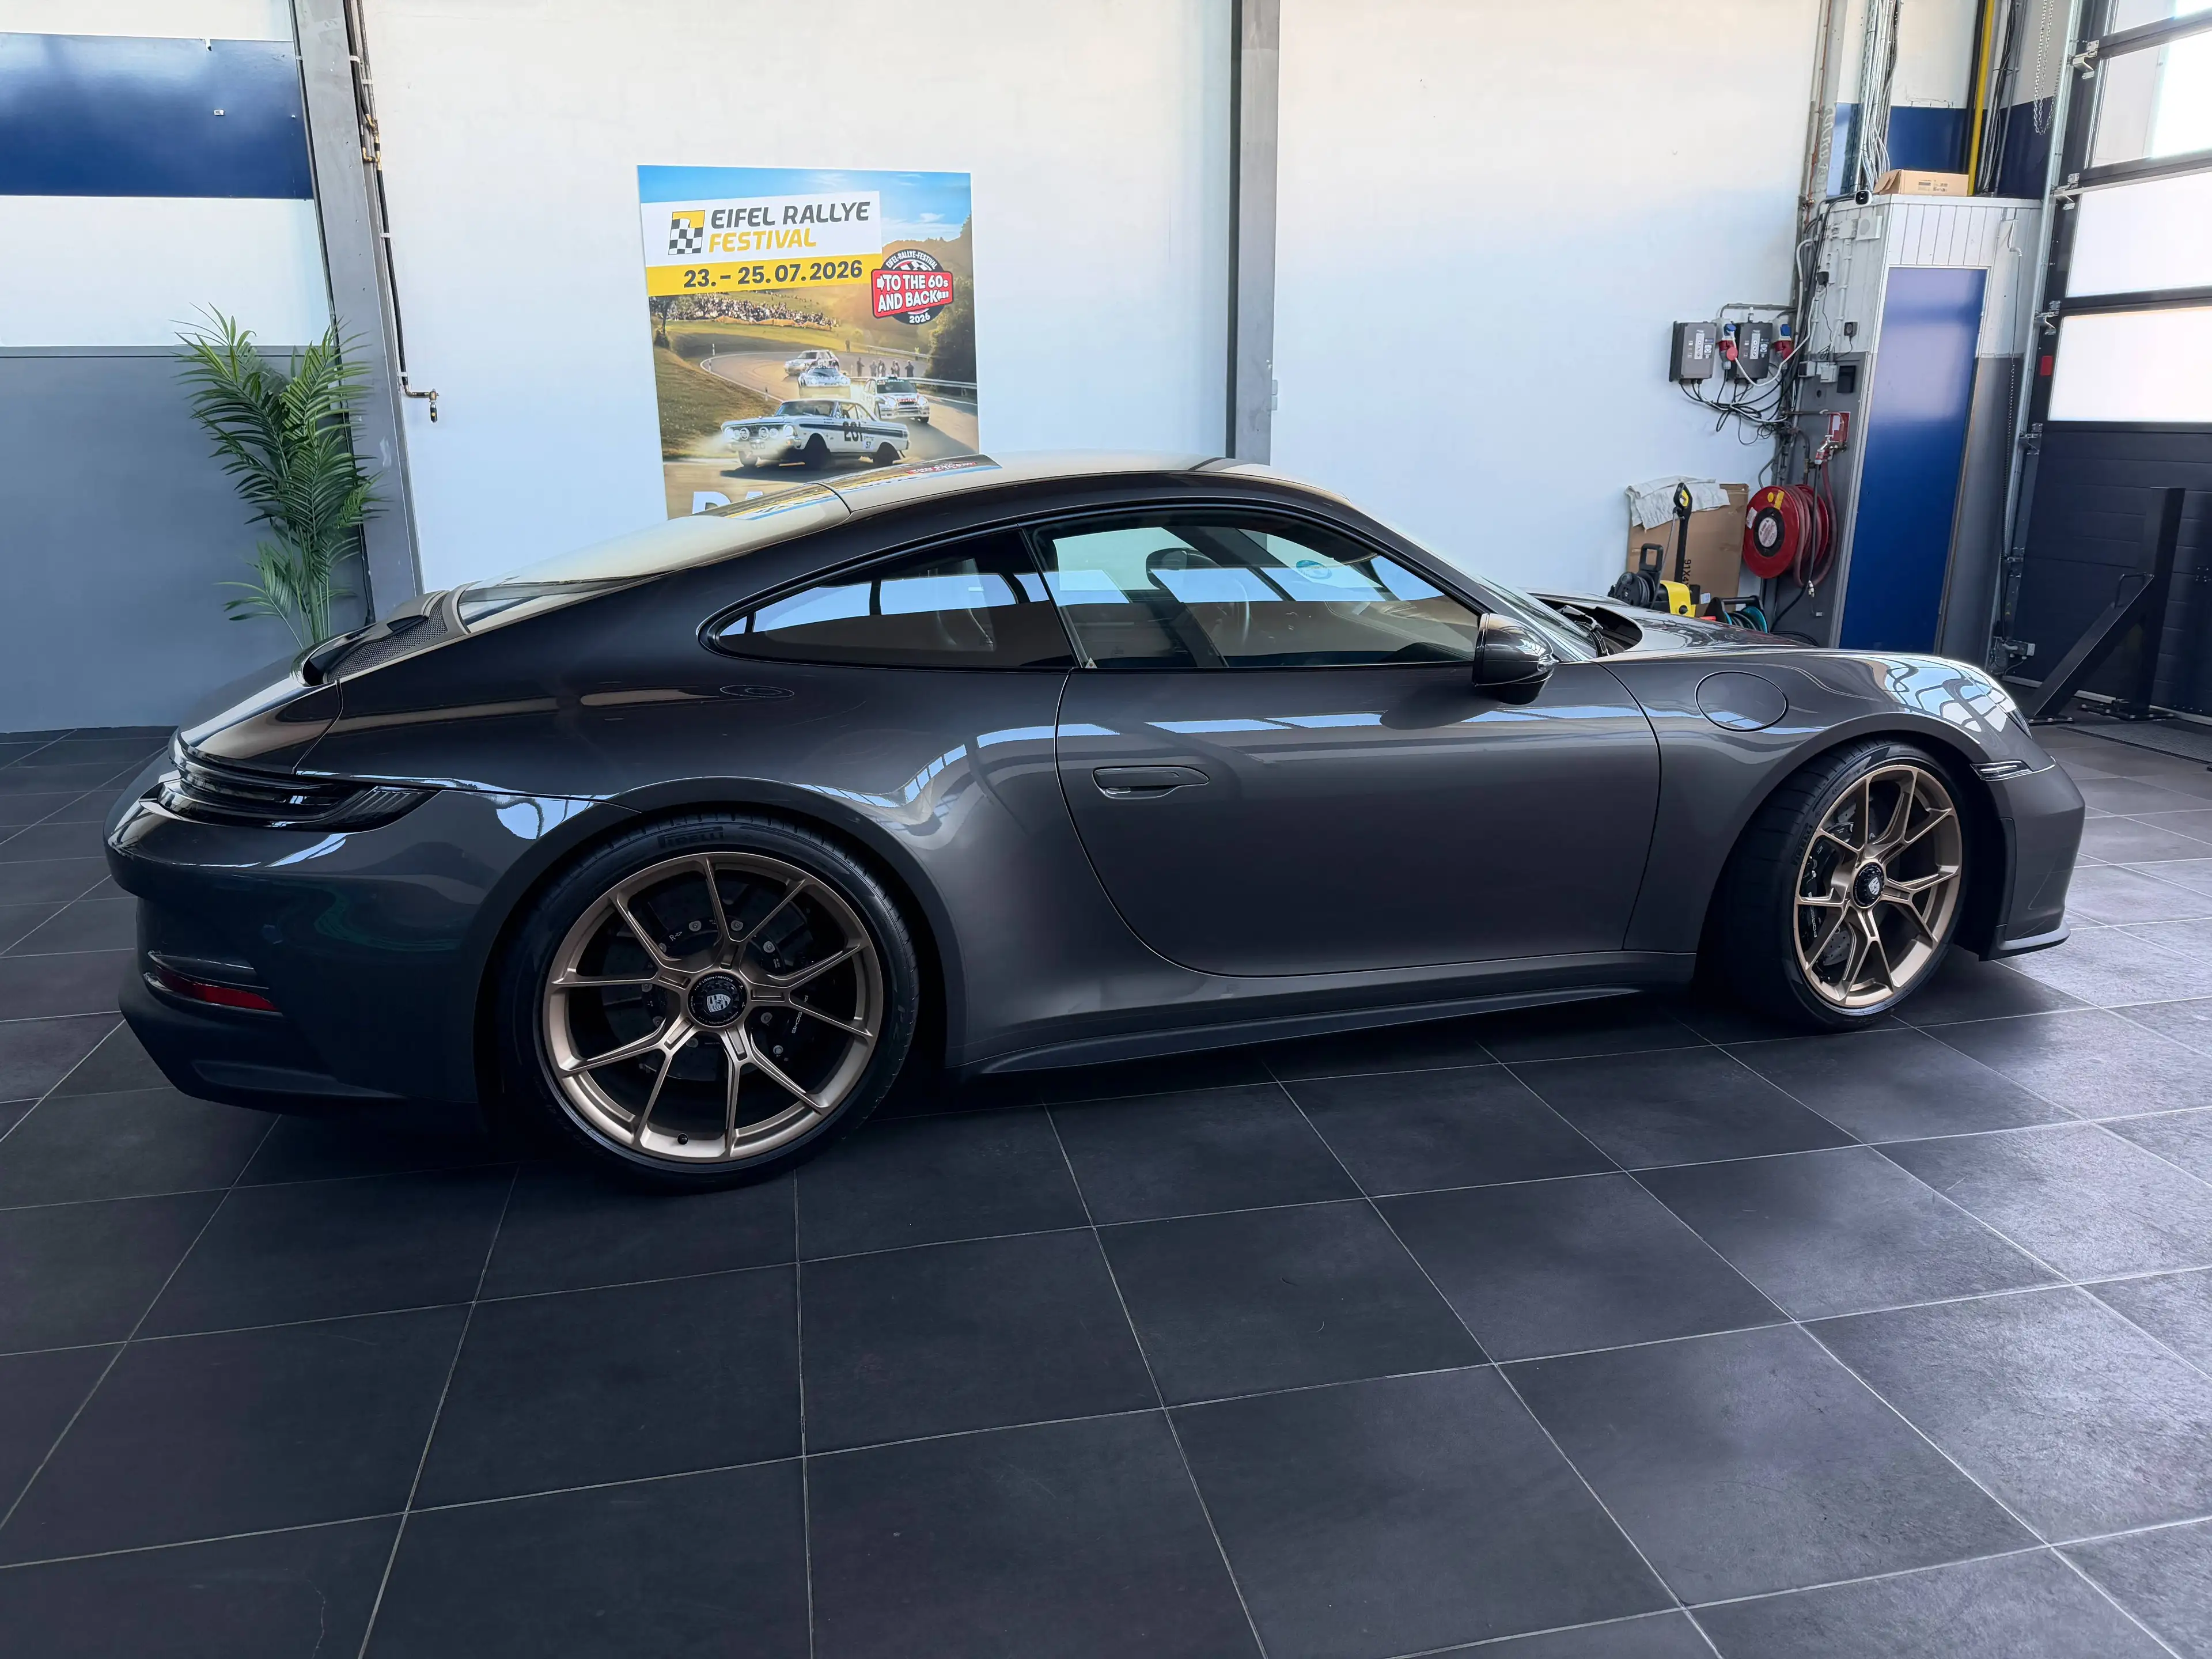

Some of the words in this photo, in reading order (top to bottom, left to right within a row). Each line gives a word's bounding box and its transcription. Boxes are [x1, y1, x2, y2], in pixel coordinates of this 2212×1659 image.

[711, 207, 775, 229] EIFEL
[783, 202, 870, 225] RALLYE
[709, 228, 817, 253] FESTIVAL
[684, 268, 717, 288] 23.
[882, 274, 902, 291] TO
[903, 274, 926, 290] THE
[928, 275, 949, 289] 60s
[877, 293, 903, 312] AND
[905, 289, 938, 308] BACK
[909, 312, 931, 324] 2026
[1808, 892, 1818, 938] PORSCE
